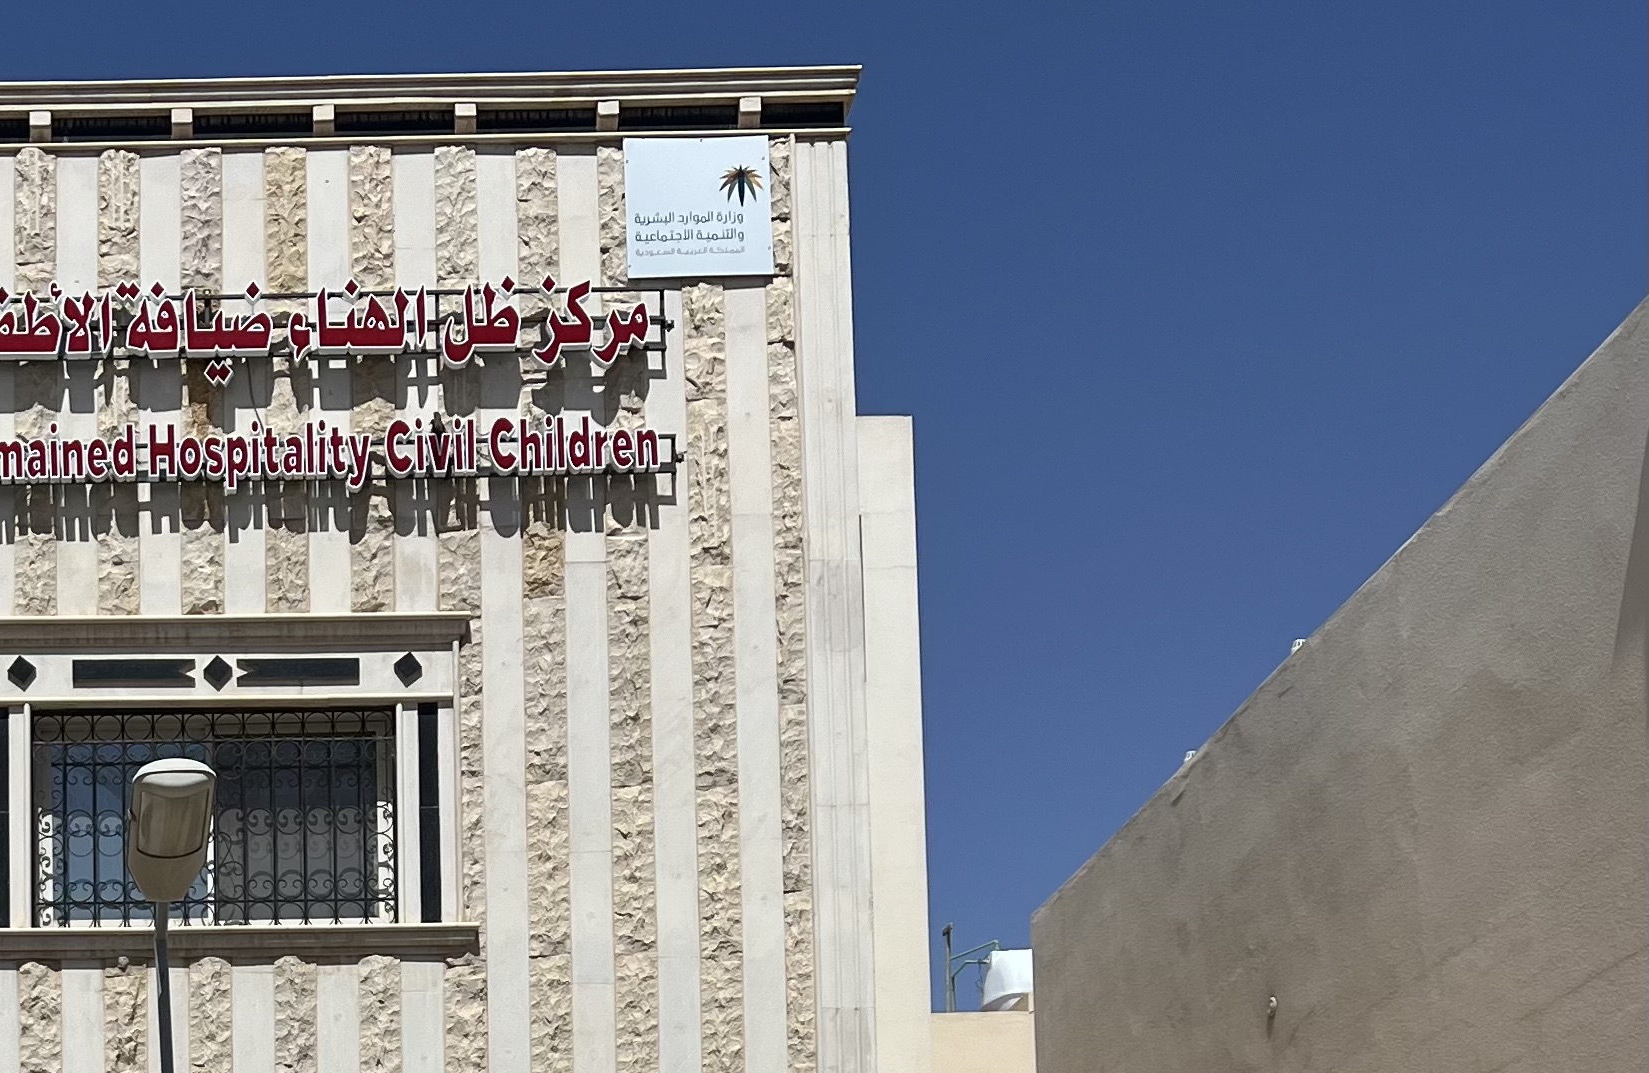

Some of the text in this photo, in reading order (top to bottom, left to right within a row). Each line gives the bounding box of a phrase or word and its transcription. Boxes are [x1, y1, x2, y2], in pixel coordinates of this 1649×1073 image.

[634, 210, 743, 225] وزارة الموارد البشرية
[635, 228, 744, 244] والتنمية الاجتماعية
[115, 281, 273, 386] ضيافة
[288, 278, 427, 361] الهناء
[444, 275, 522, 365] ظل
[533, 275, 650, 365] مركز
[149, 420, 371, 489] Hospitality
[385, 418, 476, 474] Civil
[490, 416, 659, 471] Children
